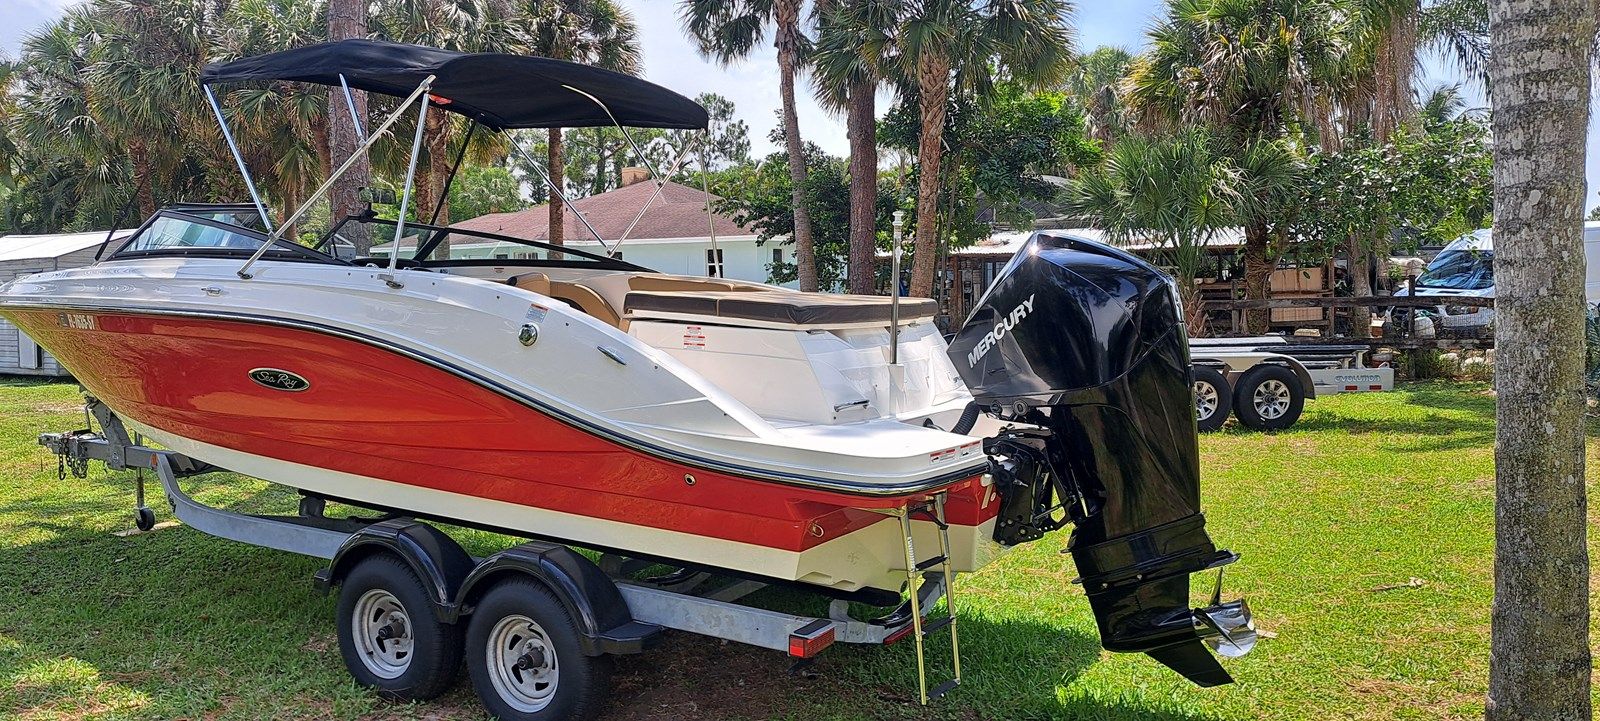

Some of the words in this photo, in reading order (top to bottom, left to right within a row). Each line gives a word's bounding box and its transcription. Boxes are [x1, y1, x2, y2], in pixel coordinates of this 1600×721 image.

[968, 293, 1035, 369] MERCURY
[257, 371, 275, 383] Sea
[277, 373, 298, 389] Ray
